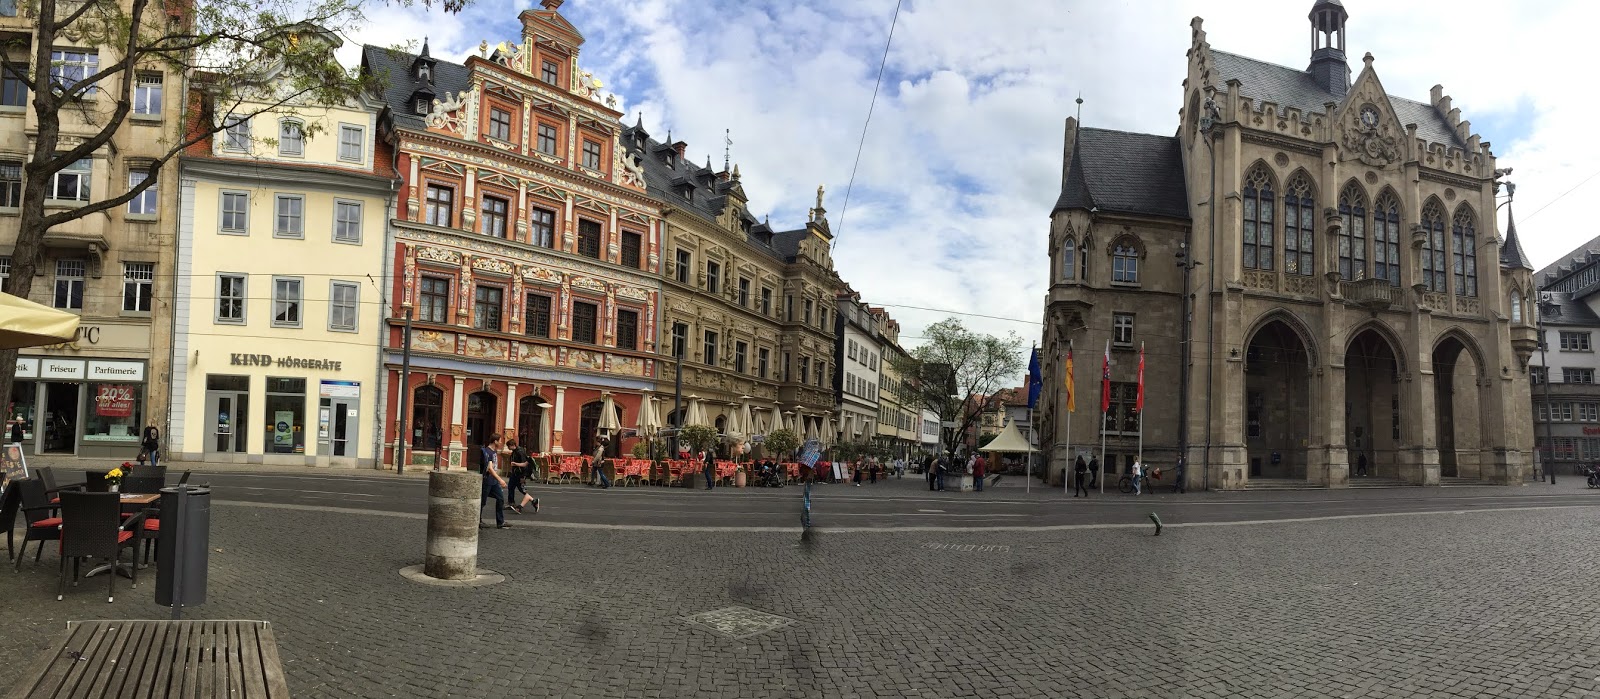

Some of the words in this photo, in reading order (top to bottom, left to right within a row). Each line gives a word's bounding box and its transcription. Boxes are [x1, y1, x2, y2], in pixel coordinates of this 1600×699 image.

[230, 353, 272, 367] KIND
[277, 356, 342, 371] HÖRGERÄTE
[49, 364, 77, 373] Friseur
[94, 366, 137, 375] Parfümerie
[101, 387, 131, 399] 20%
